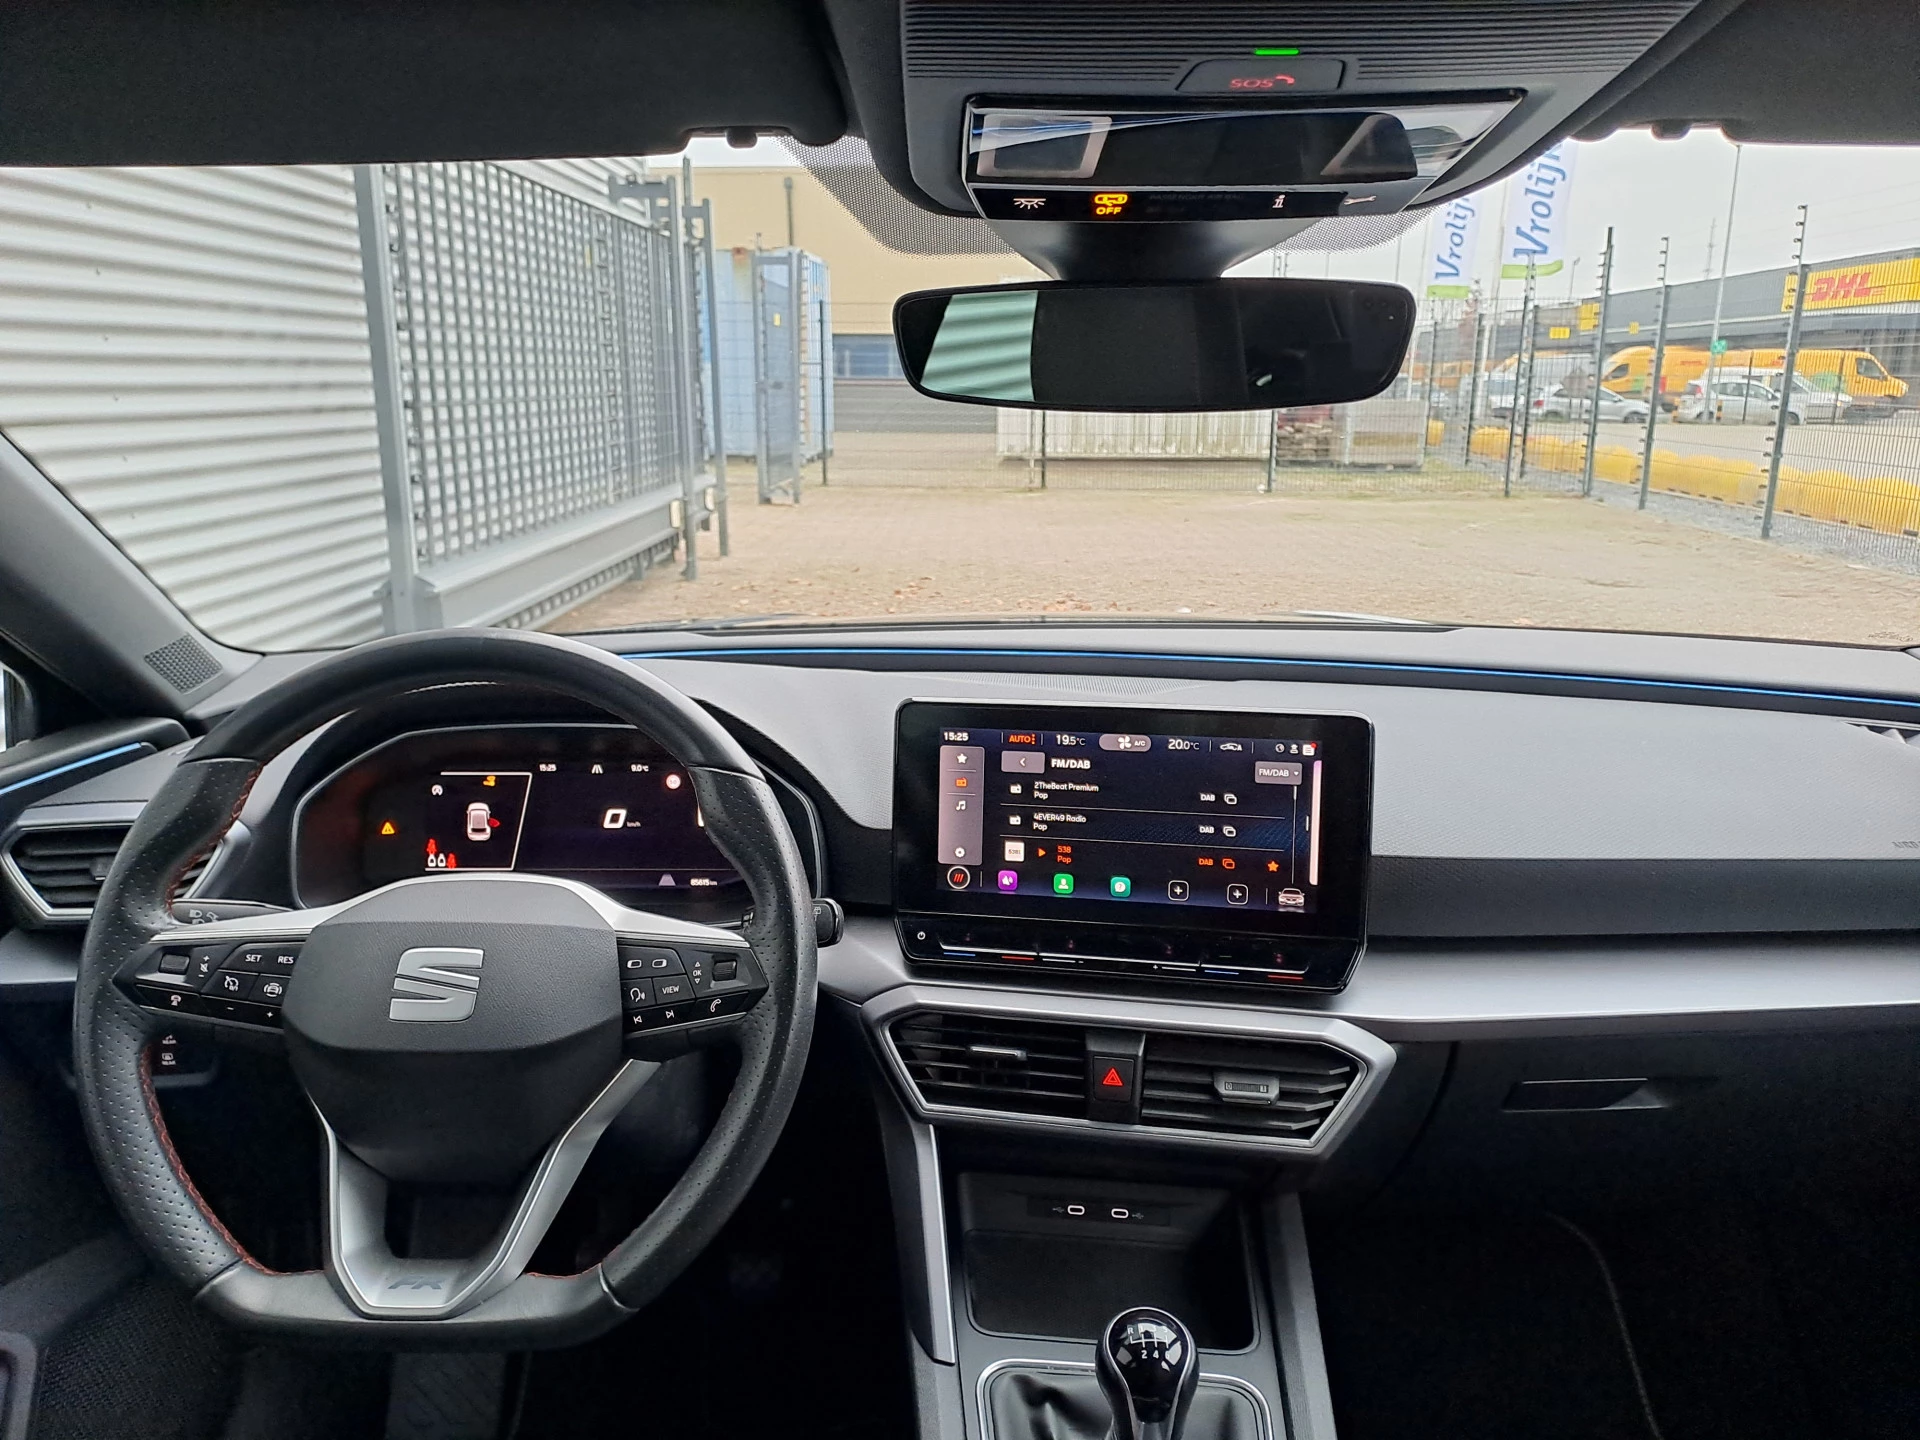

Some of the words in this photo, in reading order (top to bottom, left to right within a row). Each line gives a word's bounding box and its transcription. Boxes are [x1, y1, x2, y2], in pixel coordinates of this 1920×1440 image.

[1231, 79, 1273, 88] SOS
[1096, 207, 1121, 215] OFF
[1435, 197, 1475, 279] Vrolij
[1811, 272, 1871, 301] DHL
[944, 732, 968, 741] 15:25
[1009, 735, 1030, 743] AUTO
[1051, 758, 1091, 769] FM/DAB
[1259, 768, 1289, 777] FM/DAB
[1034, 782, 1067, 790] 2TheBeat
[1068, 783, 1099, 792] Premium
[1034, 791, 1048, 800] Pop
[1200, 793, 1215, 801] DAB
[1066, 815, 1086, 823] Radio
[1033, 823, 1047, 831] Pop
[1057, 856, 1072, 864] Pop
[1198, 857, 1213, 865] DAB
[245, 954, 262, 962] SET
[277, 956, 294, 964] RES
[692, 969, 702, 977] OK
[662, 985, 680, 995] VIEW
[1127, 1327, 1134, 1335] R
[1141, 1350, 1148, 1359] 2
[1153, 1350, 1159, 1359] 4
